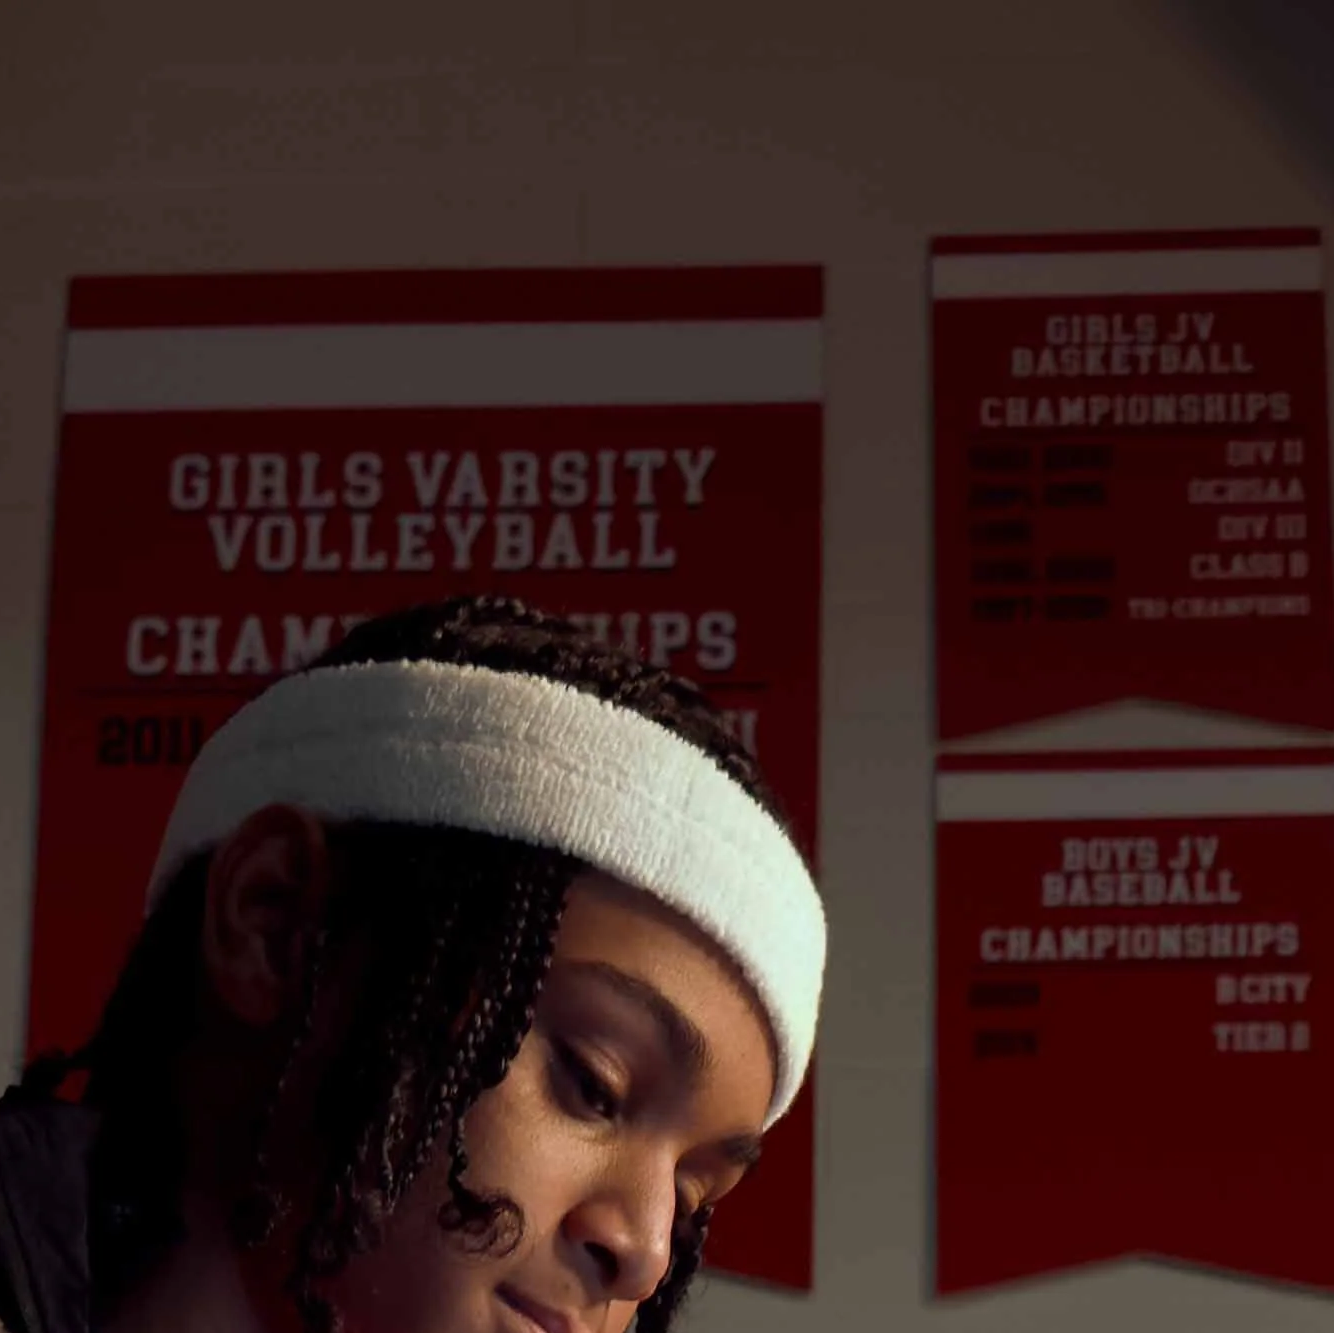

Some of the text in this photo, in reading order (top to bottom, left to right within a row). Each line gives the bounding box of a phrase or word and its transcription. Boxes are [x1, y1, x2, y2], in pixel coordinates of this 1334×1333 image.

[1045, 311, 1216, 346] GIRLS JV
[1011, 343, 1255, 378] BASKETBALL
[979, 392, 1292, 429] CHAMPIONSHIPS
[170, 447, 717, 511] GIRLS VARSITY
[208, 512, 678, 573] VOLLEYBALL
[126, 609, 739, 677] CHAMIPS
[1060, 834, 1220, 870] BOYS JV
[1041, 869, 1243, 908] BASEBALL
[979, 922, 1301, 964] CHAMPIONSHIPS
